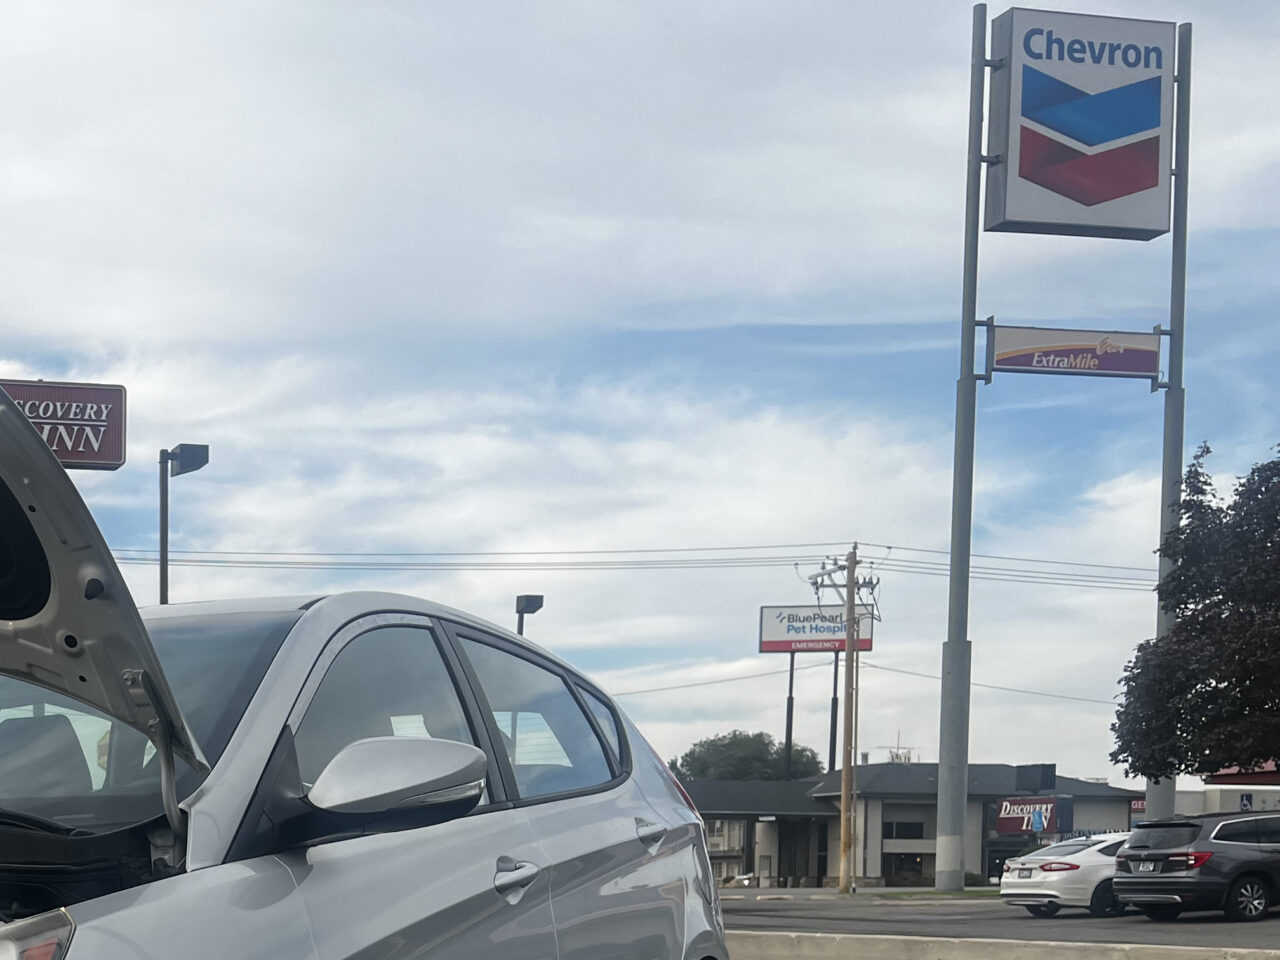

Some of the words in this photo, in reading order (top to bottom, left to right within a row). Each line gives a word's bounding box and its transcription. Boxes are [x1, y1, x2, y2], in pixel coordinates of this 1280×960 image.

[1022, 27, 1163, 70] Chevron
[1032, 352, 1099, 370] ExtraMile
[14, 400, 112, 420] SCOVERY
[41, 424, 106, 452] INN
[787, 613, 842, 623] BluePearl
[787, 625, 806, 634] Pet
[810, 624, 847, 635] Hospit
[791, 641, 840, 649] EMERGENCY
[1001, 801, 1054, 815] DISCOVERY
